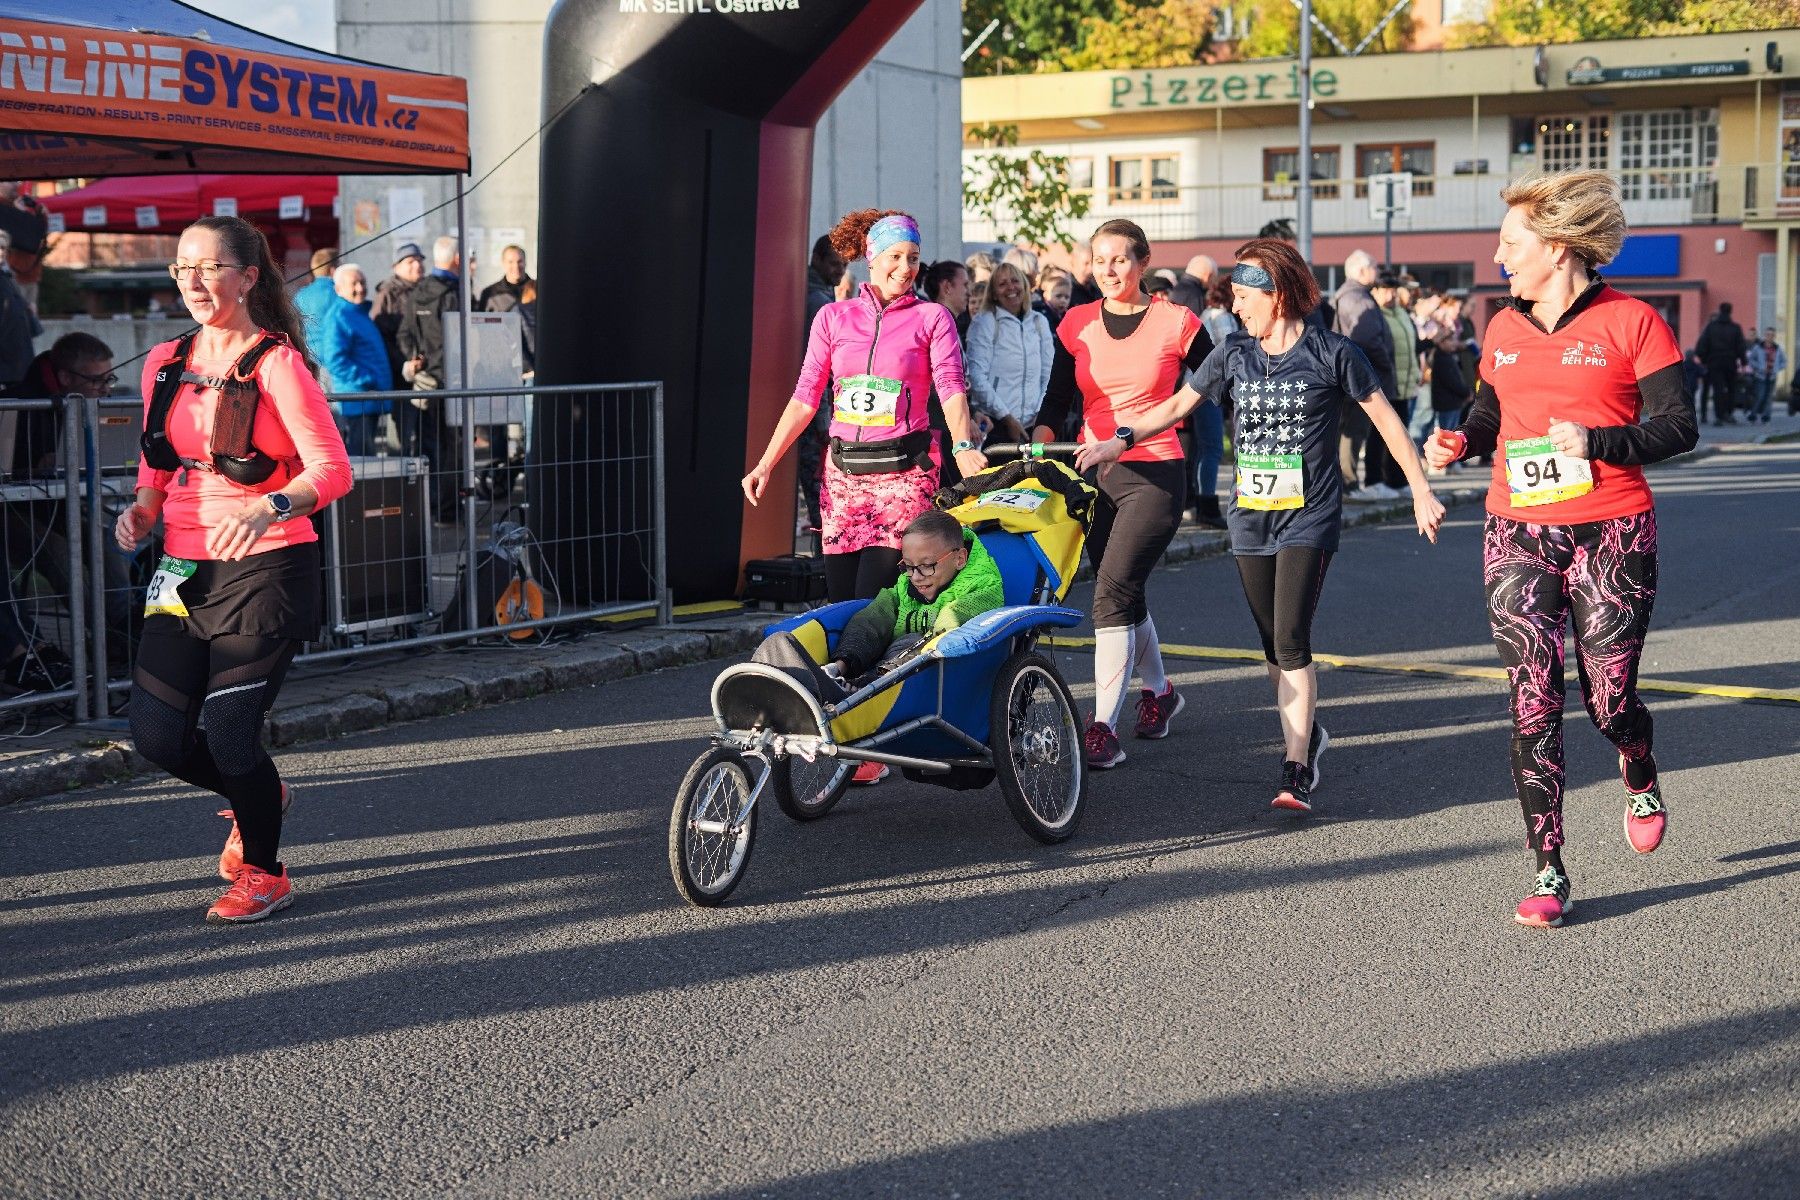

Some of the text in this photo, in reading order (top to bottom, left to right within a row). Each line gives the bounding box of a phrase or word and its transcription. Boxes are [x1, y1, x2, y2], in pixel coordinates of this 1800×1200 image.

[715, 0, 799, 13] Ostrava
[1110, 64, 1338, 109] Pizzerie
[103, 108, 160, 121] RESULTS
[167, 113, 203, 125] PRINT
[204, 117, 262, 132] SERVICES
[334, 133, 385, 146] SERVICES
[409, 142, 456, 154] DISPLAYS
[1584, 356, 1607, 367] PRO
[850, 391, 876, 413] 63
[1523, 457, 1561, 488] 94
[1252, 473, 1278, 496] 57
